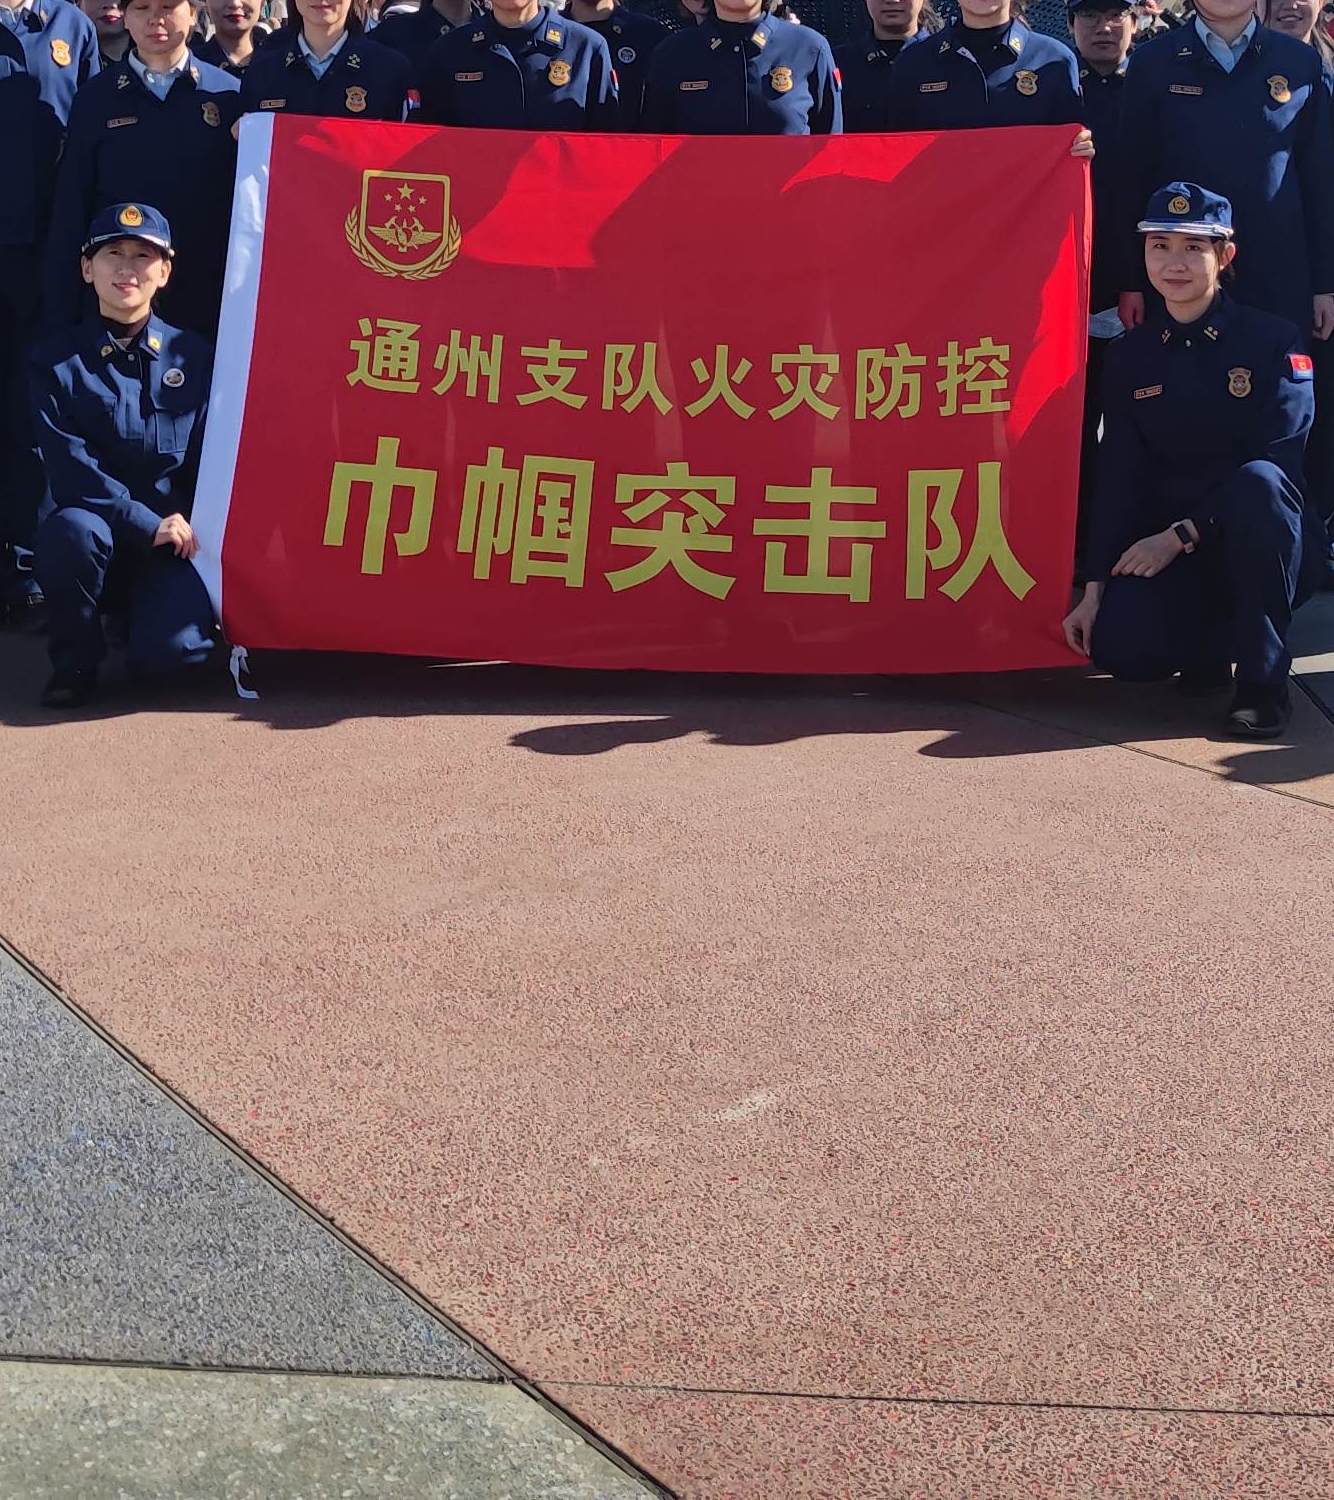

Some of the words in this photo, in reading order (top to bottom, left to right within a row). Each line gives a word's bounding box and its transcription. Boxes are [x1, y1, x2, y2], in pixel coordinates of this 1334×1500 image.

[346, 317, 1013, 422] 通州支队火灾防控
[323, 436, 1037, 604] 巾帼突击队
